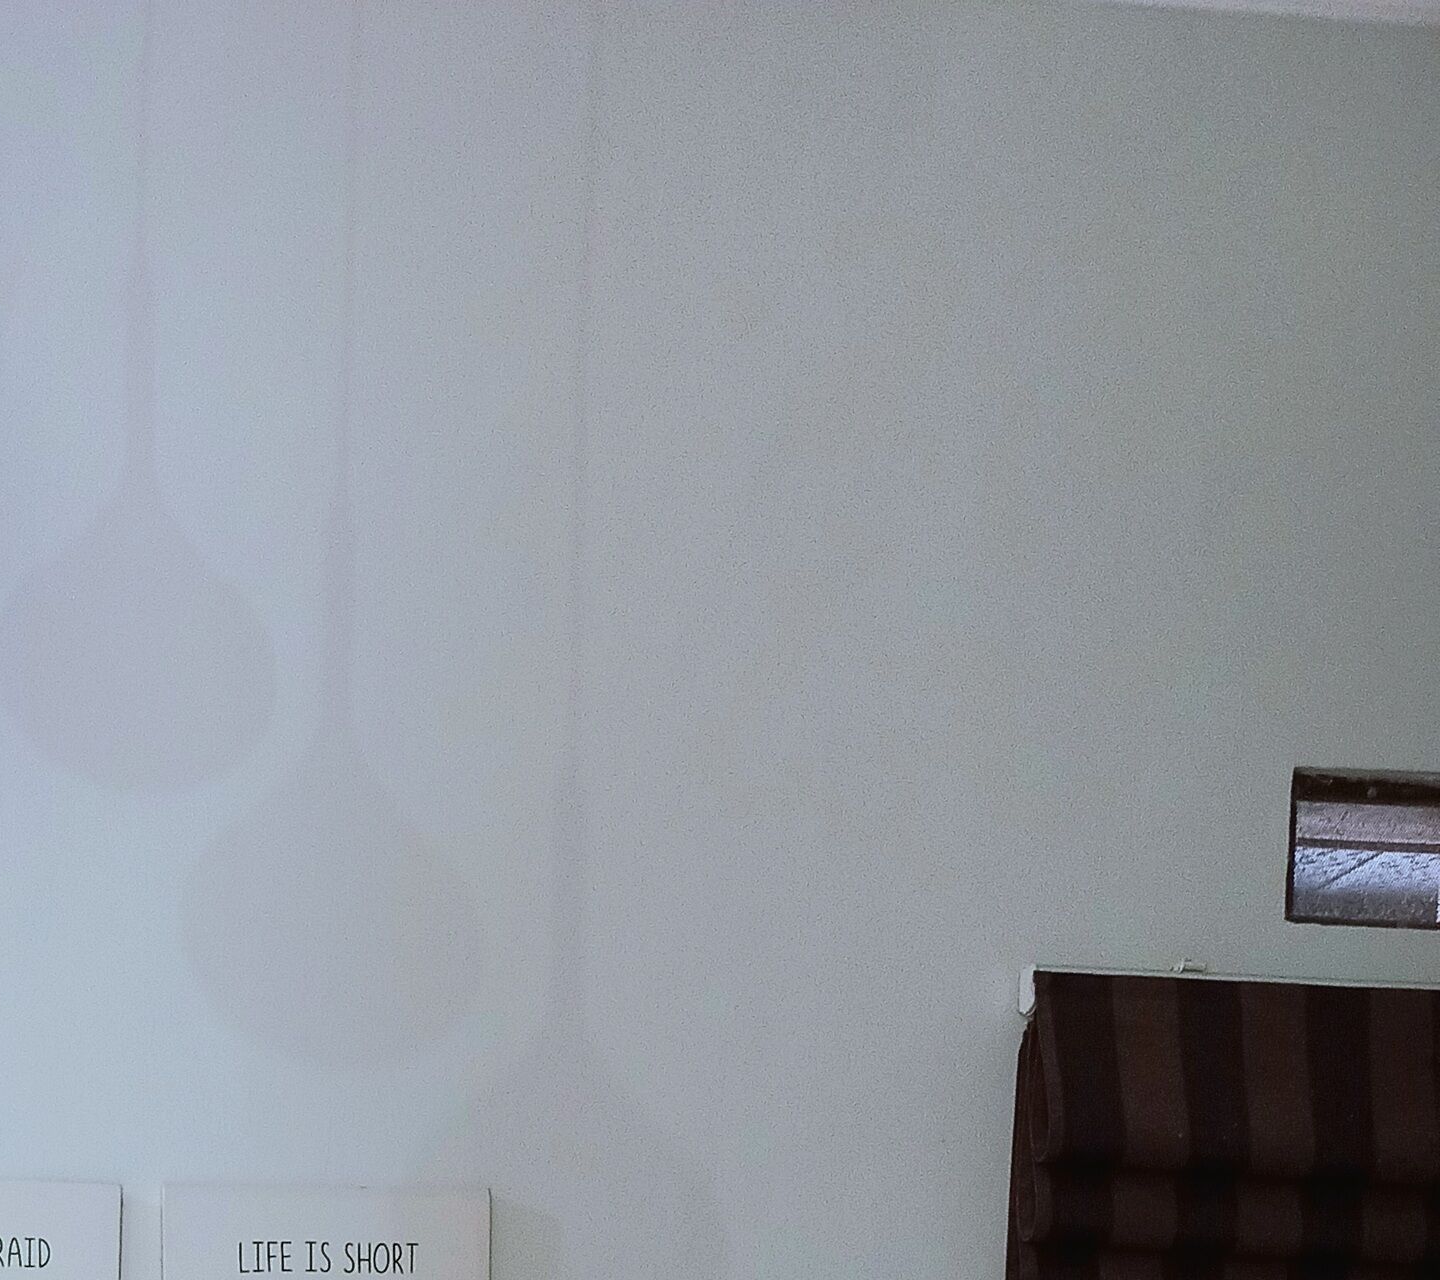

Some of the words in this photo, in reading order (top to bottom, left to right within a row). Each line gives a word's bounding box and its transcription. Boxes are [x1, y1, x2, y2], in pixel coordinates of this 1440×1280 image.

[238, 1241, 293, 1274] LIFE
[305, 1241, 333, 1274] IS
[343, 1243, 420, 1275] SHORT
